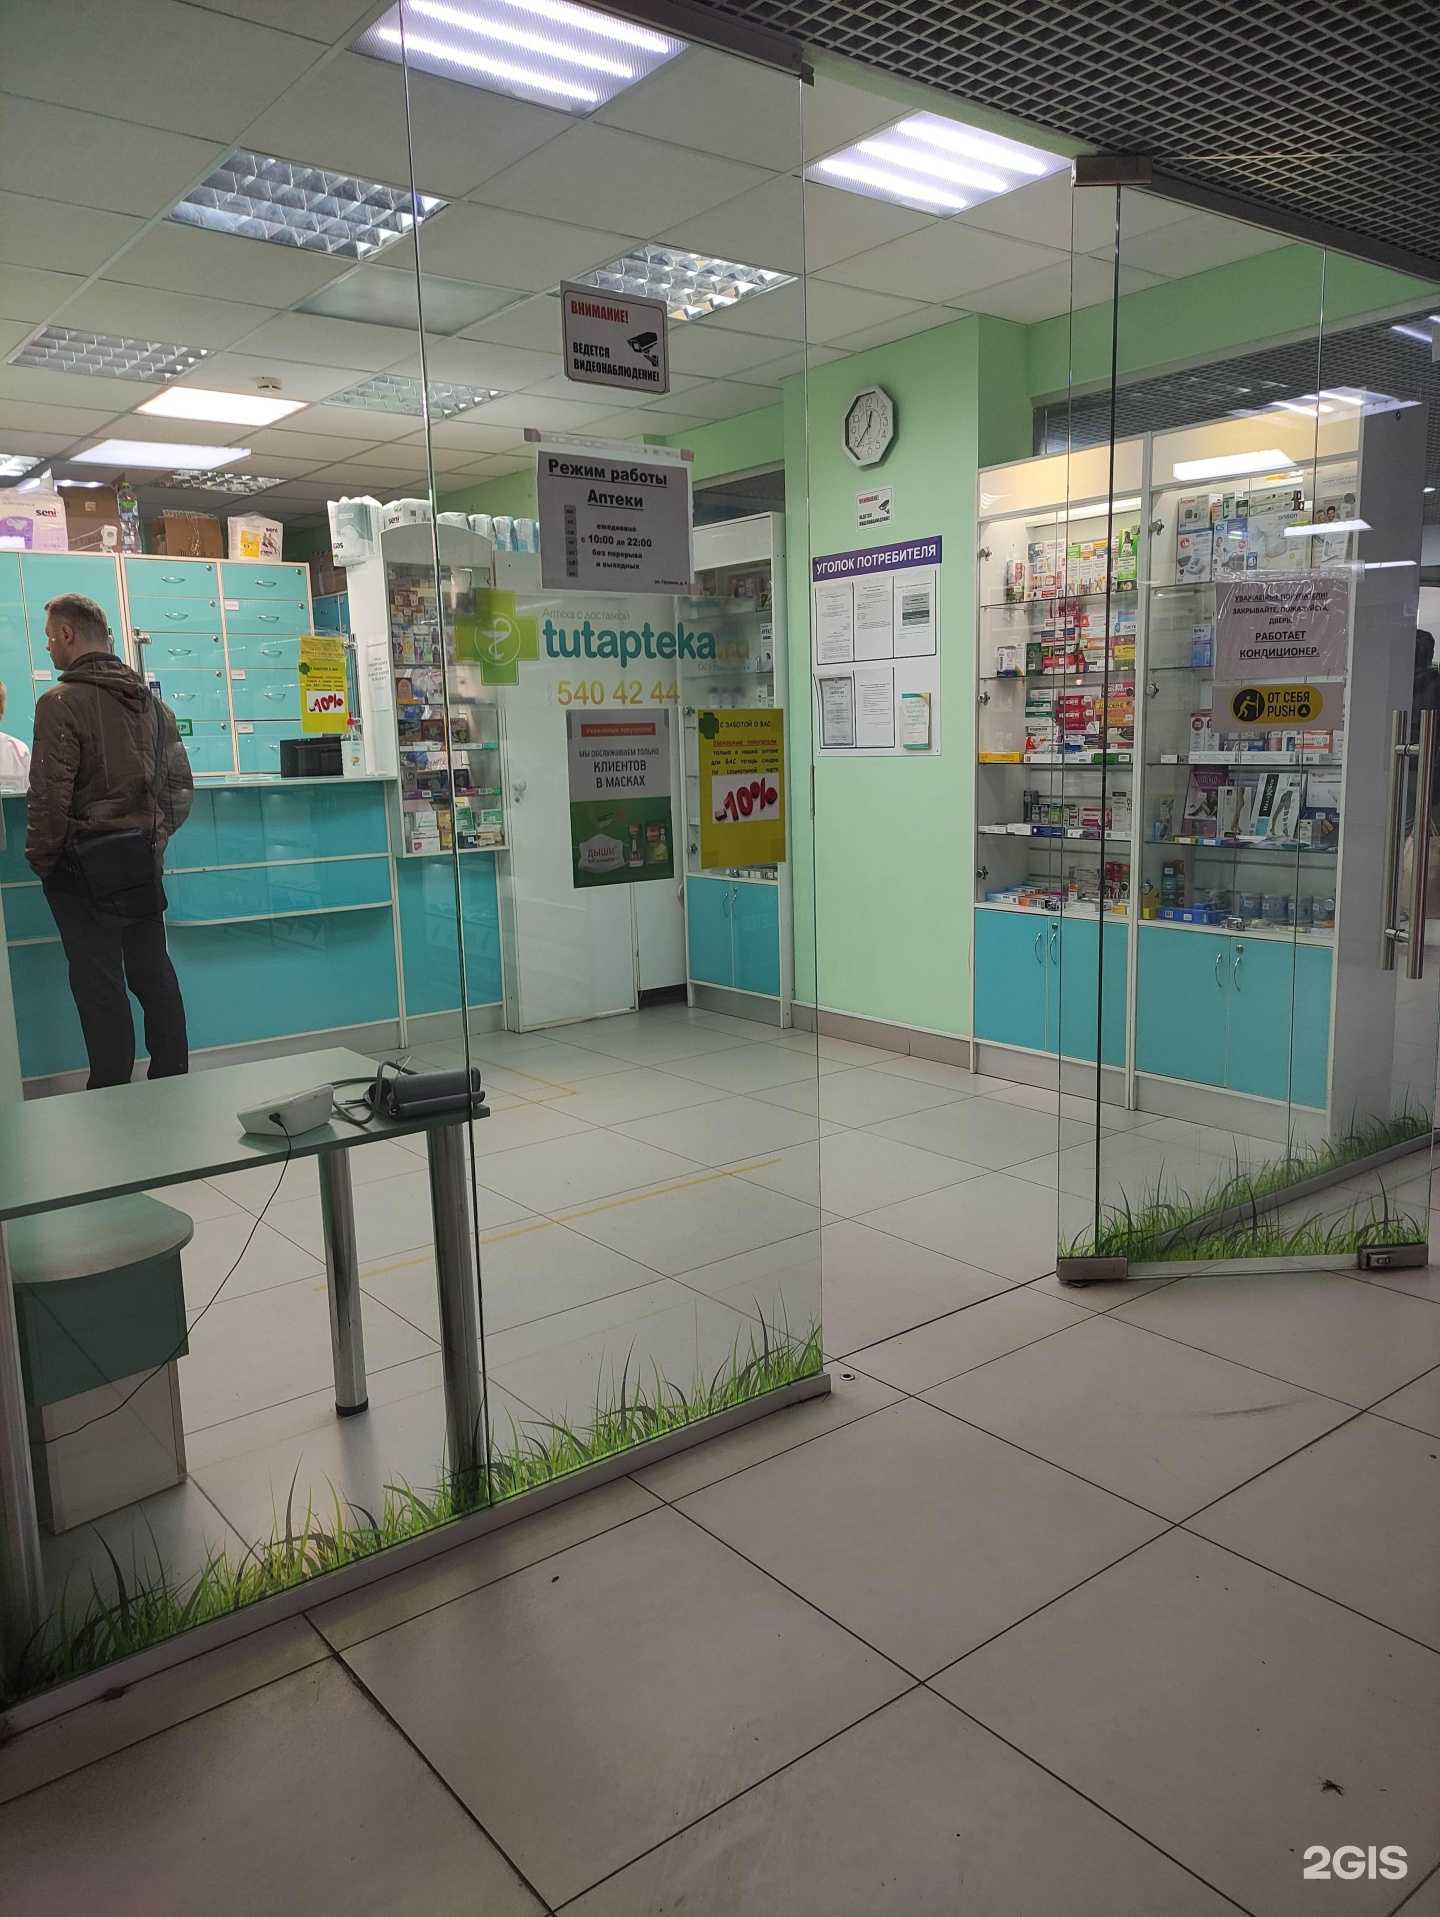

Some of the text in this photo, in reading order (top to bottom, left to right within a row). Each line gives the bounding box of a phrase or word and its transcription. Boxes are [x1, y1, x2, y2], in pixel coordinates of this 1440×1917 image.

[571, 300, 629, 324] ВНИМАНИЕ!
[573, 342, 610, 359] ВЕДЕТСЯ
[573, 358, 660, 382] ВИДЕОНАБЛЮДЕНИЕ!
[549, 458, 668, 485] Режим работы
[587, 489, 644, 508] Аптеки
[35, 508, 57, 518] seni
[588, 534, 614, 544] 10:00
[626, 537, 652, 547] 22:00
[816, 544, 936, 575] УГОЛОК ПОТРЕБИТЕЛЯ
[1280, 604, 1329, 613] ПОЖАЙСТА,
[1255, 631, 1306, 641] РАБОТАЕТ
[1240, 646, 1320, 658] КОНДИЦИОНЕР.
[557, 679, 681, 705] 540 42 44
[1267, 691, 1311, 703] ОТ СЕБЯ
[309, 693, 344, 713] -10%
[1267, 705, 1296, 717] PUSH
[593, 760, 647, 773] КЛИЕНТОВ
[596, 775, 646, 788] В МАСКАХ
[715, 777, 778, 821] -10%
